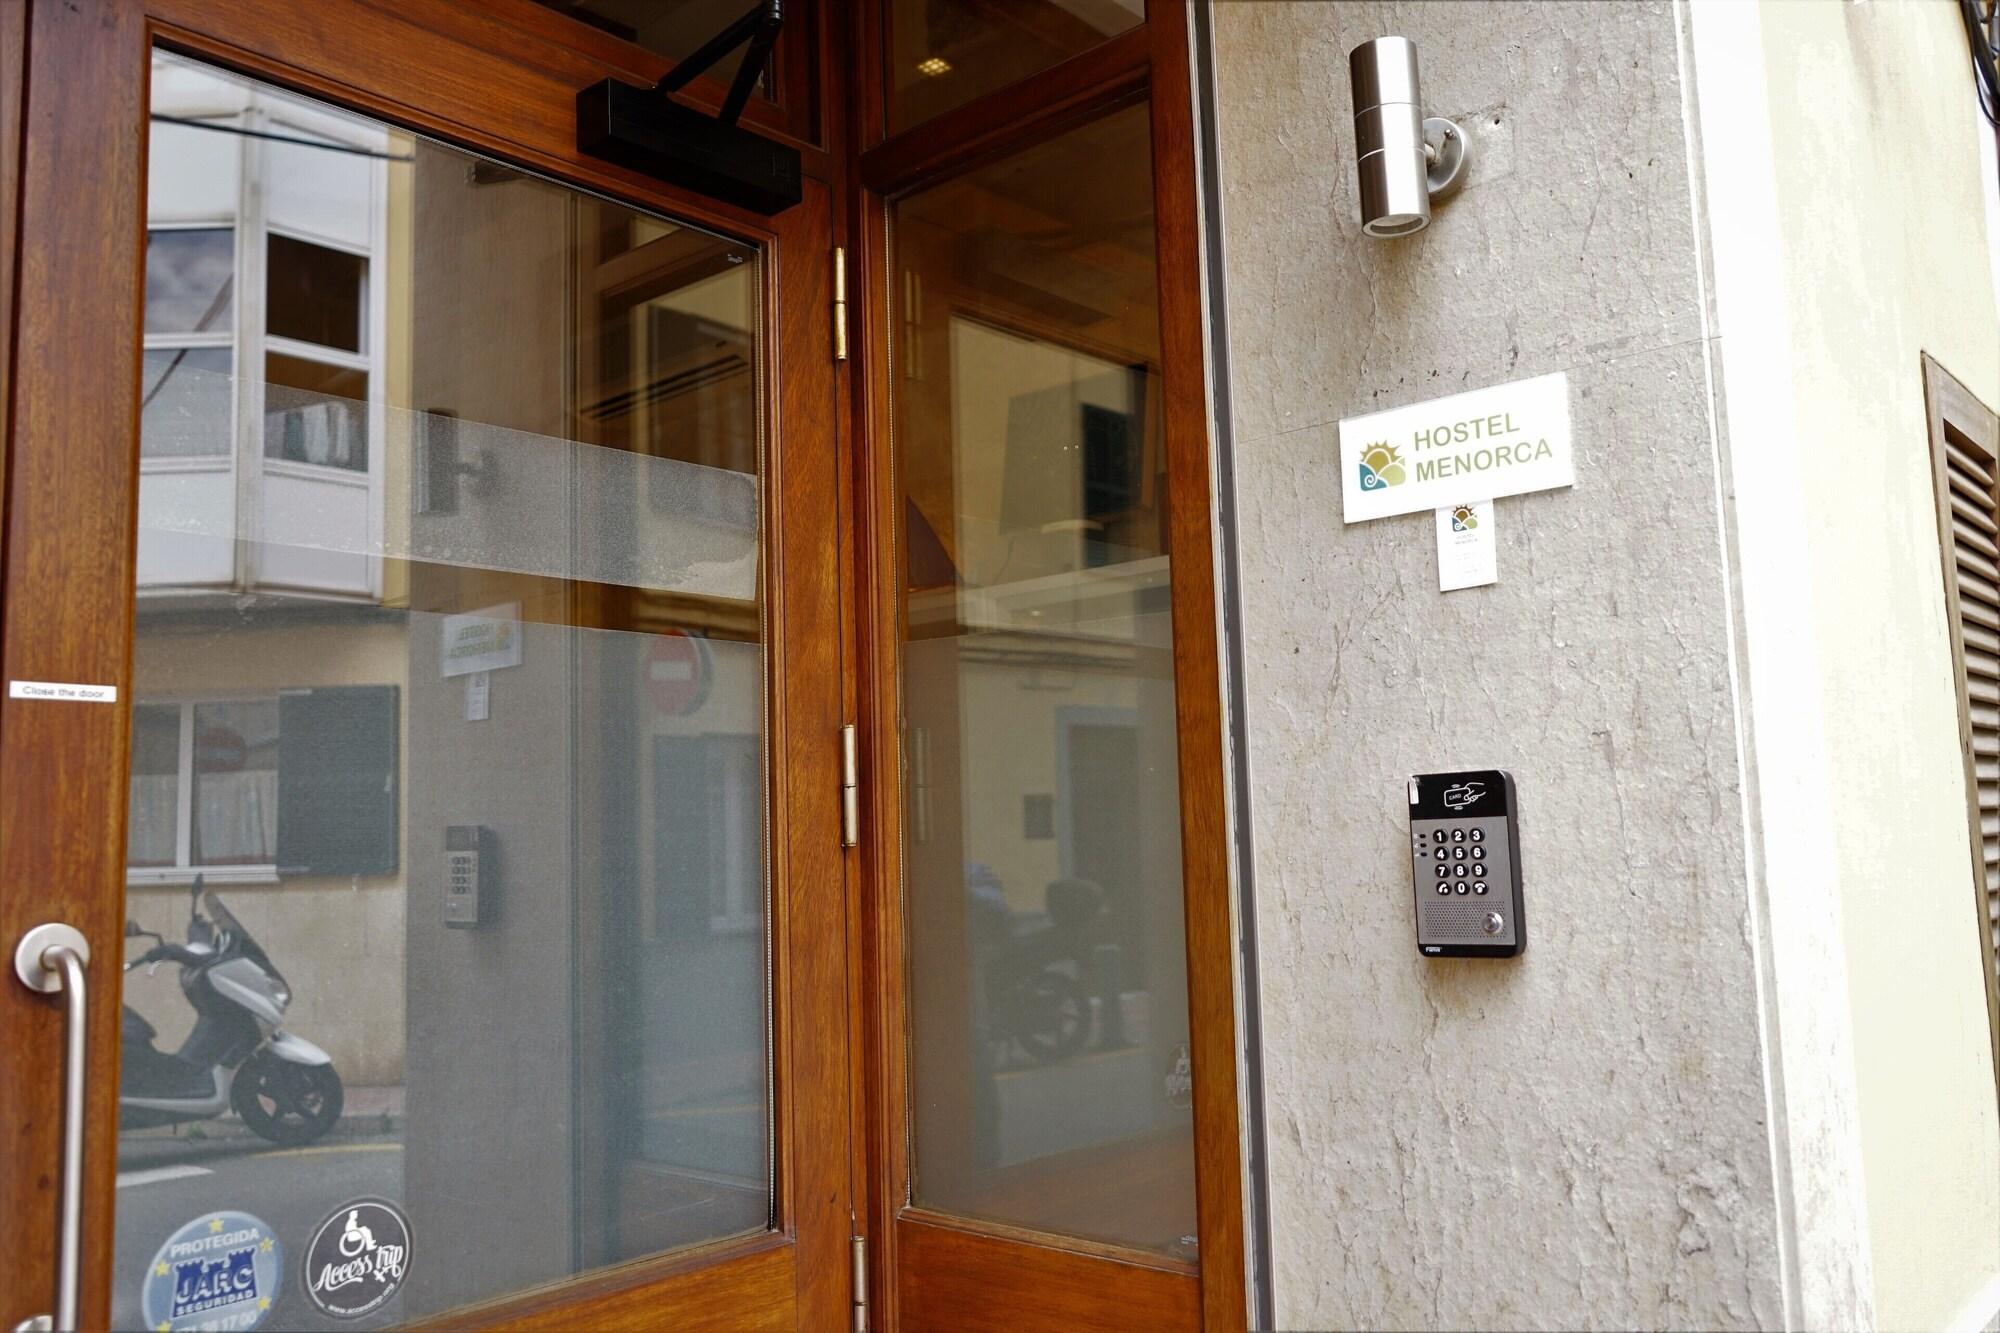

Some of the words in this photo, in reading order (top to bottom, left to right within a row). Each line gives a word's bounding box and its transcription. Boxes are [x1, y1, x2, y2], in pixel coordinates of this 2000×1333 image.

[1414, 412, 1520, 451] HOSTEL
[1416, 438, 1553, 482] MENORCA
[22, 685, 55, 696] Close
[58, 687, 76, 697] the
[79, 689, 104, 698] door
[1448, 793, 1462, 801] CARD
[1436, 831, 1443, 842] 1
[1454, 830, 1462, 841] 2
[1472, 830, 1481, 841] 3
[1436, 848, 1445, 859] 4
[1455, 848, 1463, 859] 5
[1473, 847, 1482, 858] 6
[1438, 866, 1446, 877] 7
[1456, 865, 1464, 876] 8
[1475, 864, 1483, 876] 9
[1457, 883, 1466, 893] 0
[170, 1227, 260, 1258] PROTEGIDA
[311, 1254, 373, 1292] Access
[373, 1244, 404, 1283] trip
[175, 1263, 253, 1304] JARC
[175, 1289, 254, 1316] SEGURIDAD
[222, 1314, 238, 1332] 17
[239, 1310, 258, 1328] 00
